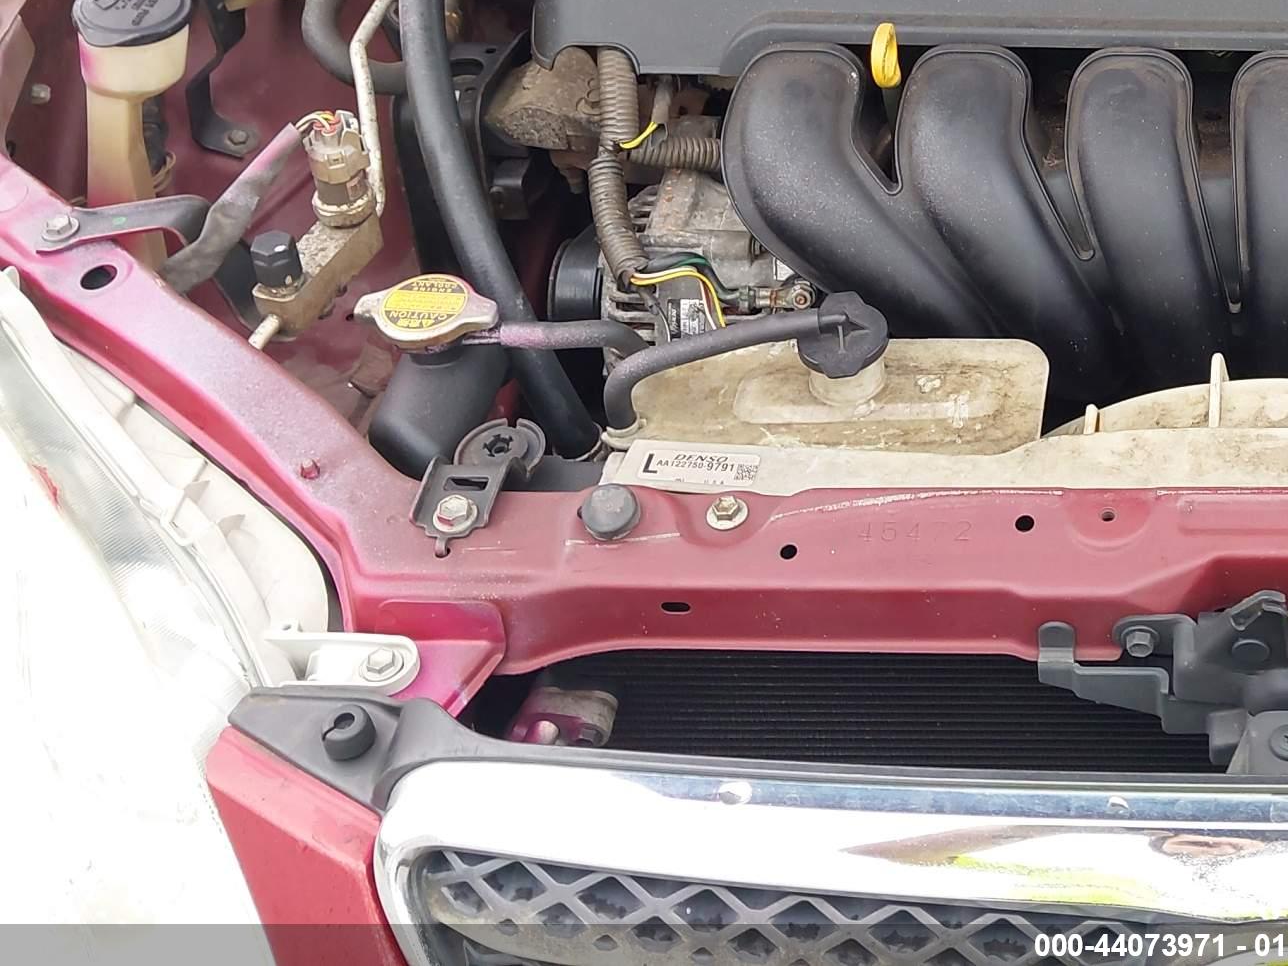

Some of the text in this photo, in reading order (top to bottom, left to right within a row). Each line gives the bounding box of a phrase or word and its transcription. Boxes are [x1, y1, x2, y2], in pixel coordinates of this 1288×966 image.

[388, 311, 448, 320] CAUTION
[674, 453, 729, 463] DENSO
[642, 453, 658, 474] L
